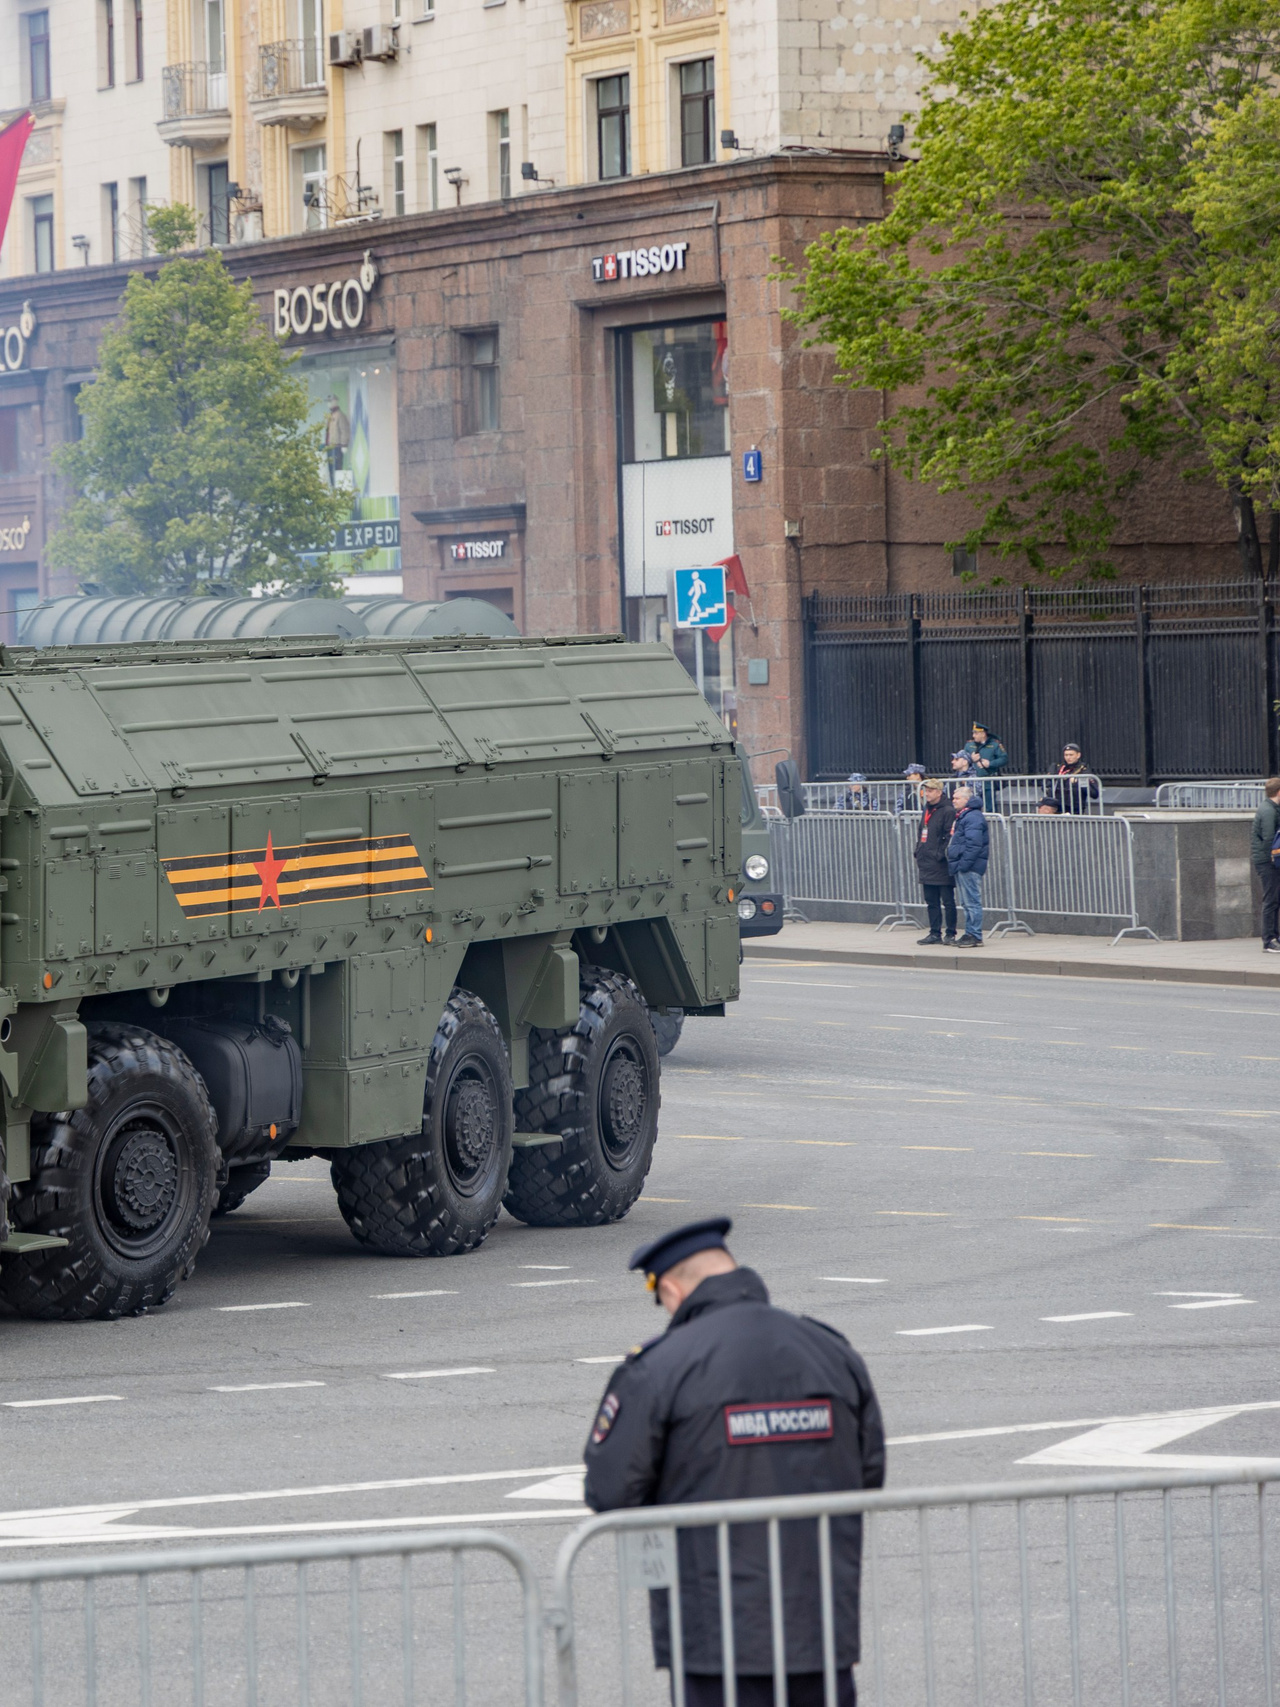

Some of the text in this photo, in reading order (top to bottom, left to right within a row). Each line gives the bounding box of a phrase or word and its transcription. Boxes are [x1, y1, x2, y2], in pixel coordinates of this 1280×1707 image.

[617, 242, 687, 278] TISSOT
[273, 279, 363, 335] BOSCO
[746, 456, 756, 476] 4
[344, 525, 398, 546] EXPEDI
[672, 518, 714, 535] TISSOT
[465, 540, 504, 558] TISSOT
[729, 1407, 830, 1436] МВД РОССИИ
